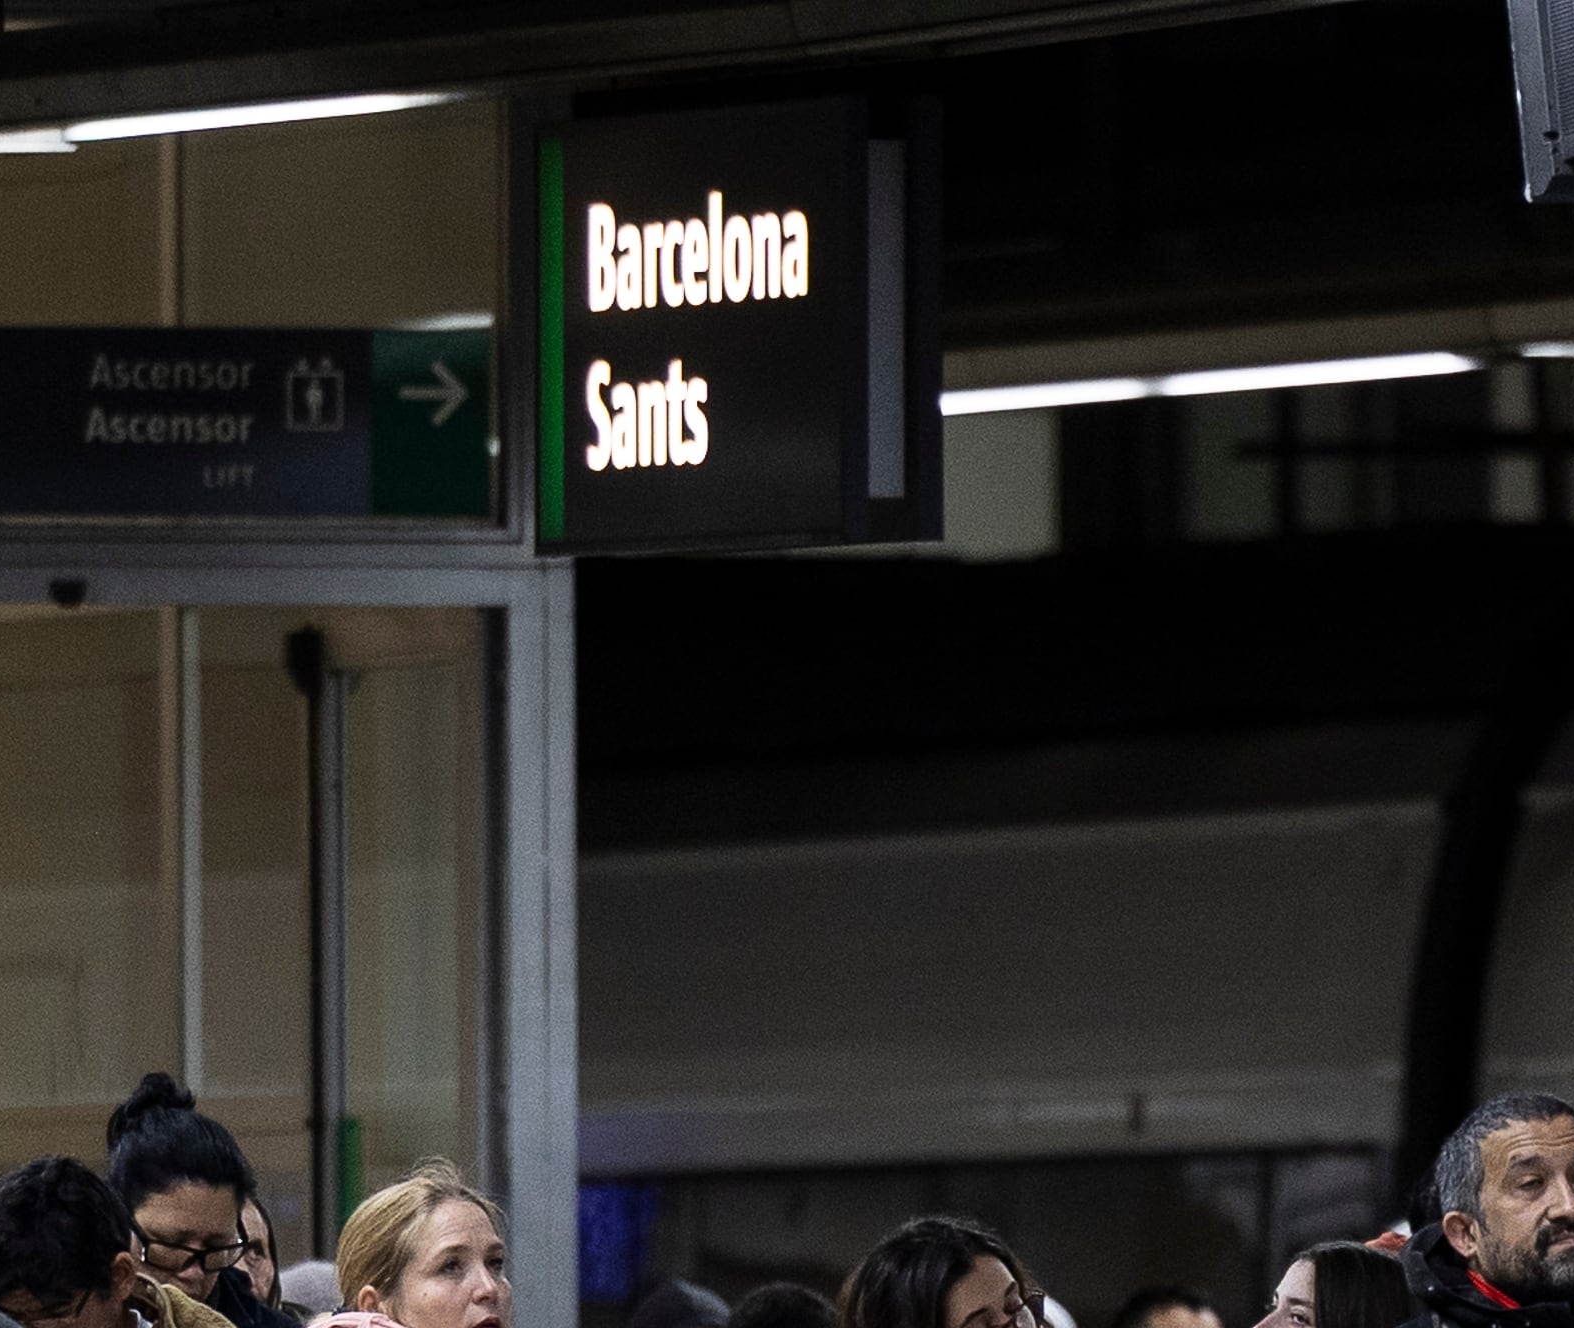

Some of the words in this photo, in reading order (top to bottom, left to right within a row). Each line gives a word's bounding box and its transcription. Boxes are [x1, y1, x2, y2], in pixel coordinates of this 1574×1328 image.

[587, 190, 809, 313] Barcelona
[89, 353, 255, 390] Ascensor
[85, 406, 256, 443] Ascensor
[586, 358, 709, 472] Sants
[203, 464, 256, 490] LIFT
